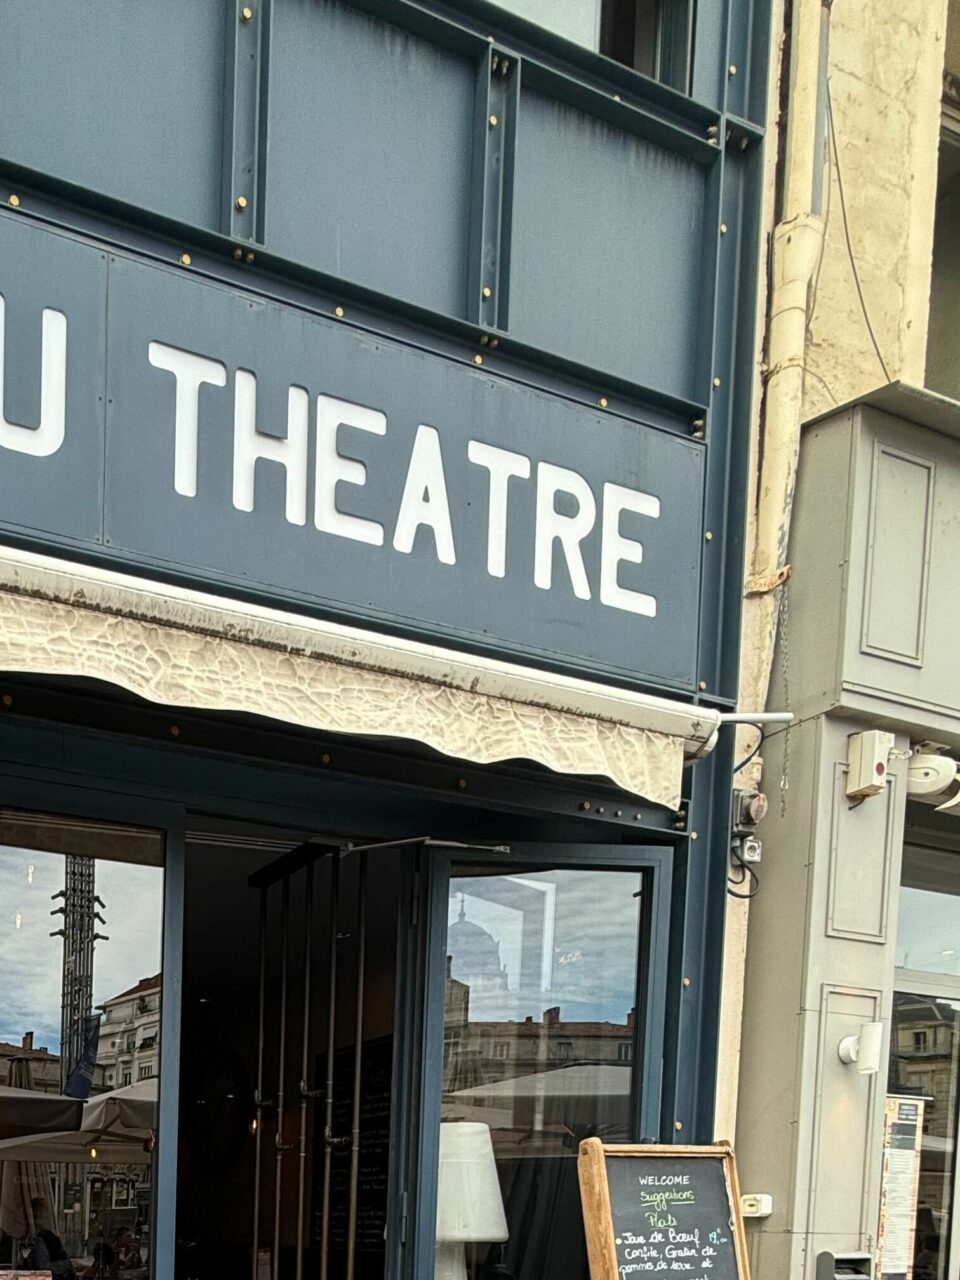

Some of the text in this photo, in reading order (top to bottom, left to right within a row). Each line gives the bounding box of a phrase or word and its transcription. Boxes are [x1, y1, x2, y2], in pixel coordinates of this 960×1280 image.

[148, 339, 661, 618] THEATRE
[638, 1175, 690, 1185] WELCOME
[640, 1188, 695, 1211] Suggestions
[645, 1211, 678, 1228] Plats
[649, 1231, 665, 1243] de
[665, 1245, 698, 1258] Gratin
[701, 1245, 717, 1256] de
[619, 1258, 714, 1276] pommes de terre et
